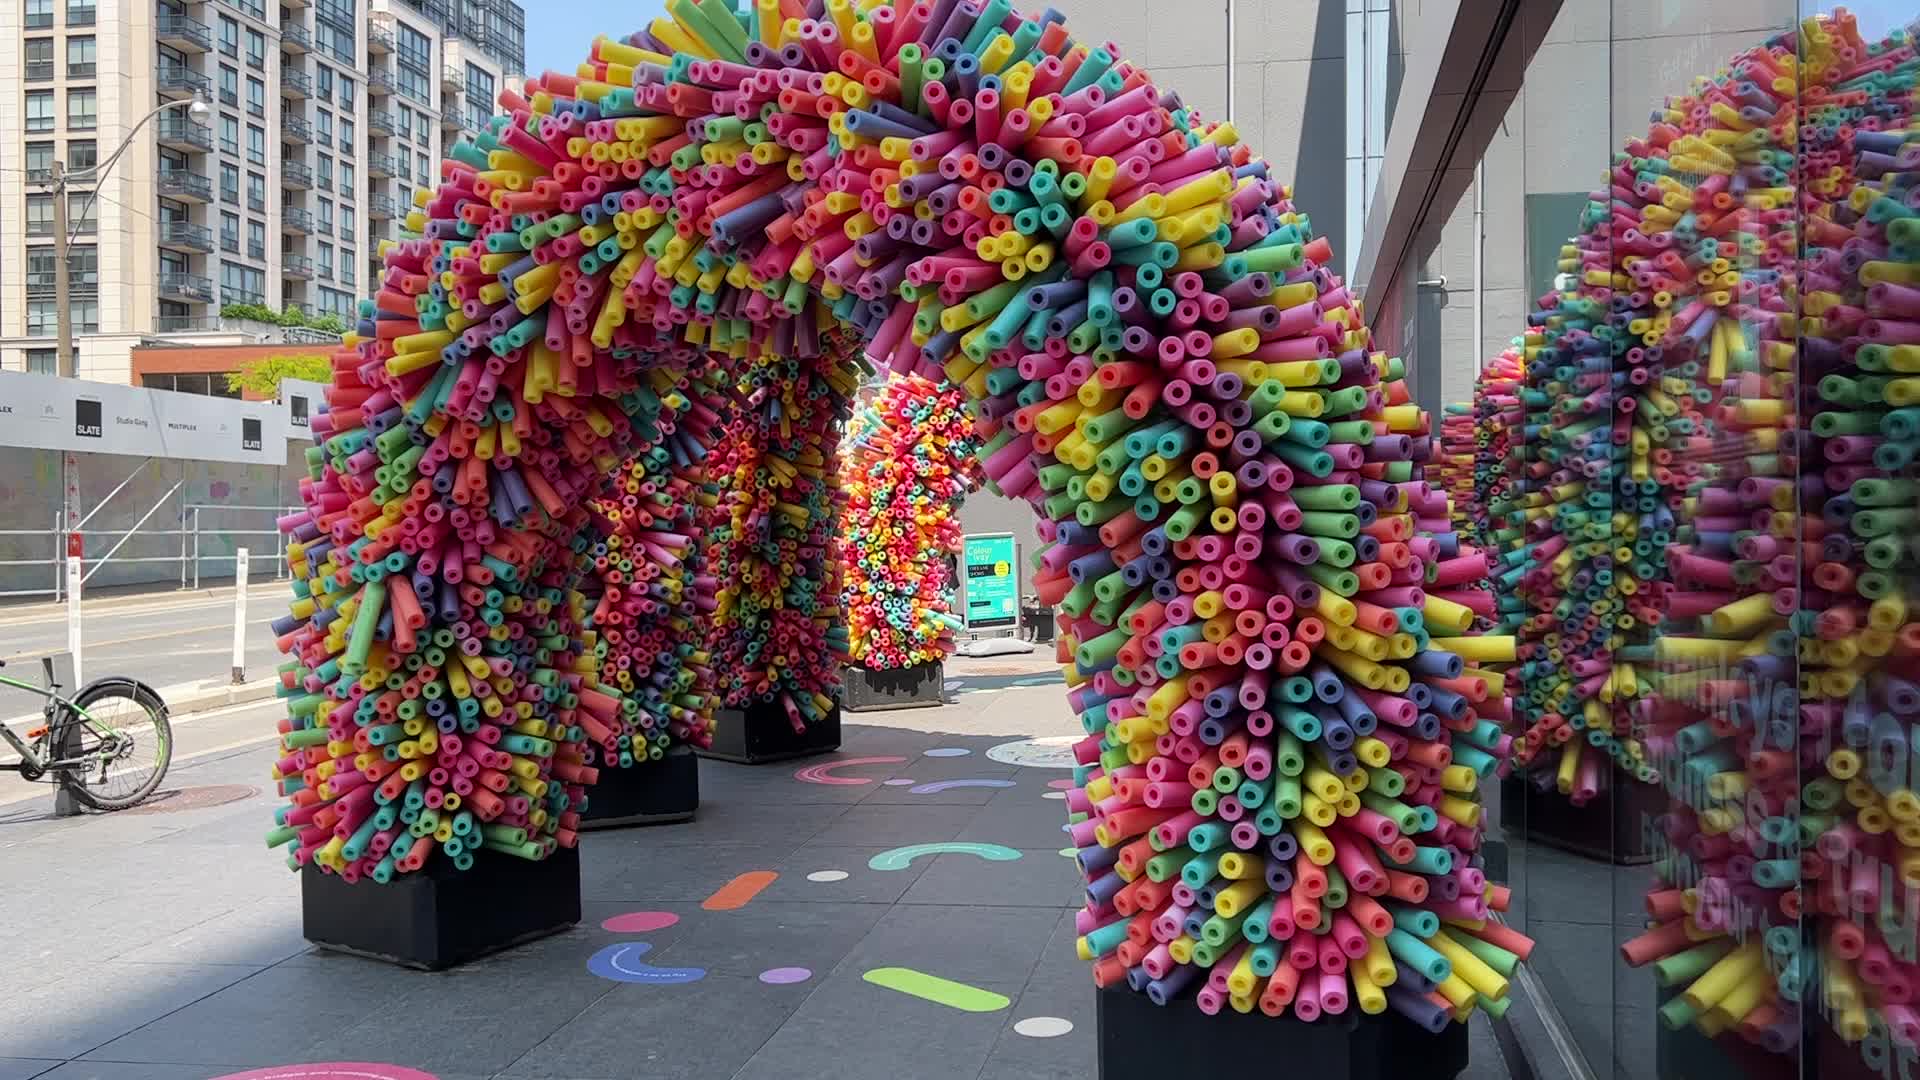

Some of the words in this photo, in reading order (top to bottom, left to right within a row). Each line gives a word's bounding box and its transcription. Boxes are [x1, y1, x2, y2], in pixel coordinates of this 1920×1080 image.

[116, 416, 133, 424] Studio
[292, 416, 307, 425] SLATE
[77, 425, 101, 436] SLATE
[168, 423, 197, 431] MULTIPLEX
[243, 440, 260, 449] SLATE
